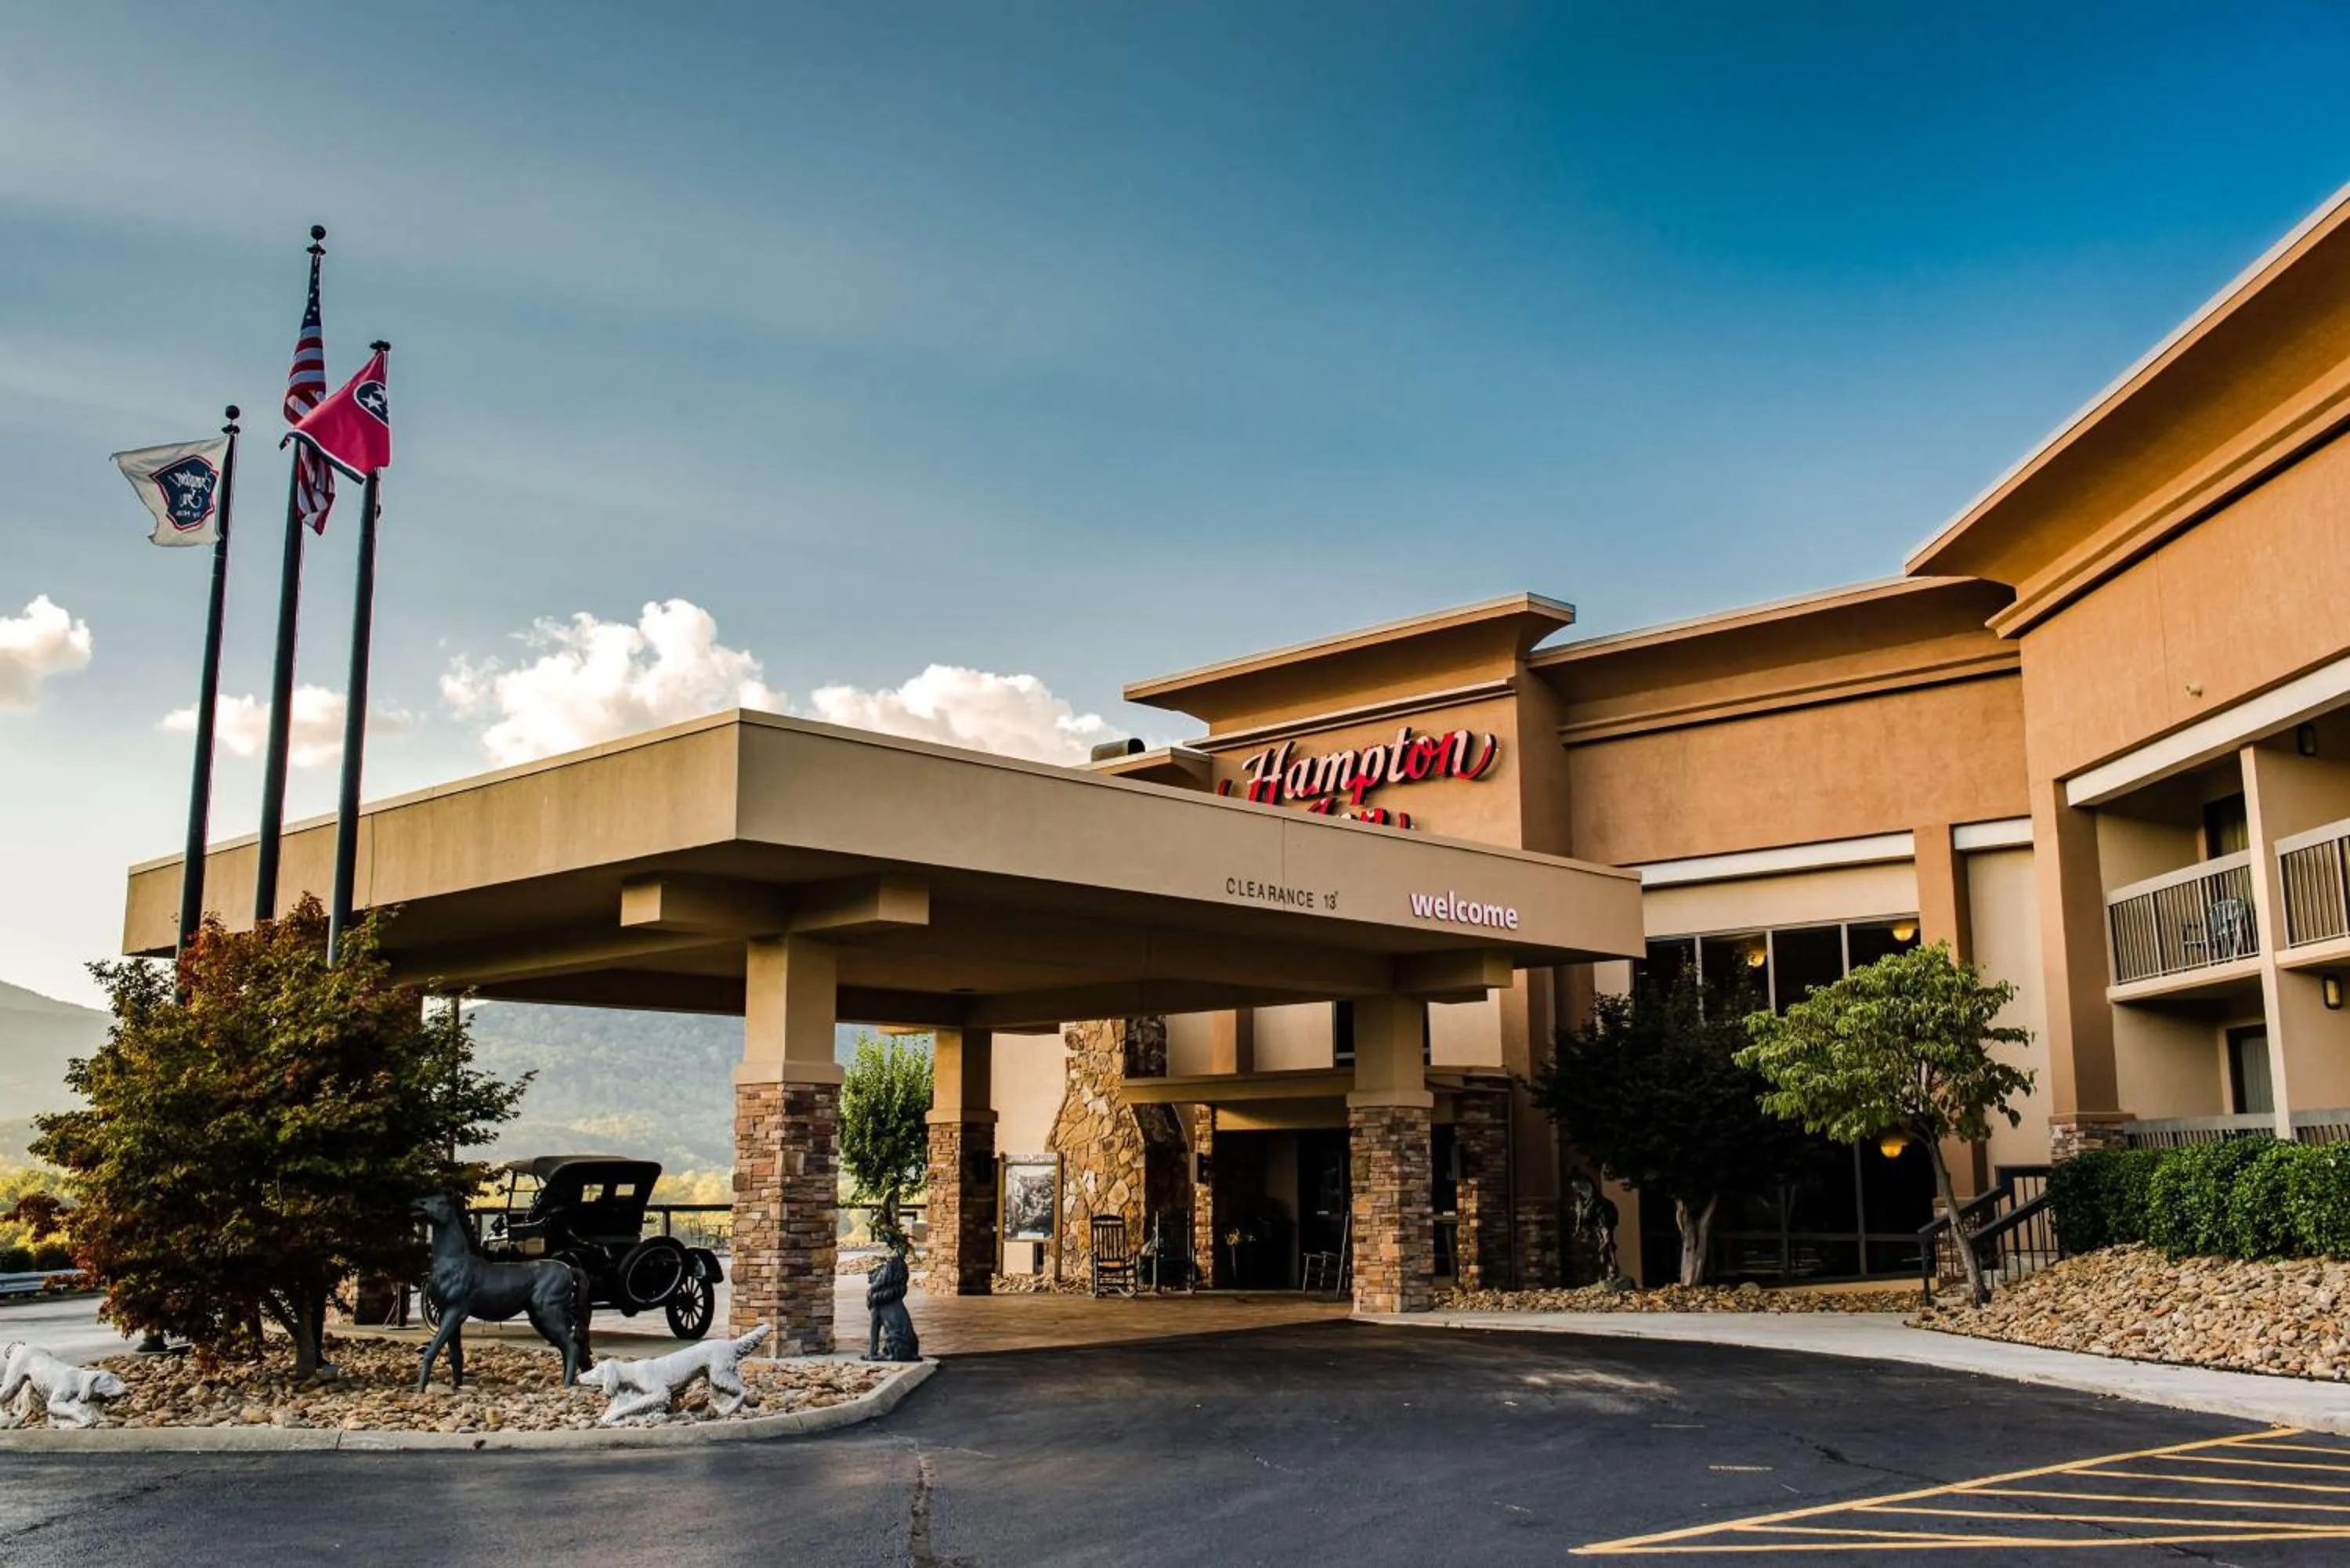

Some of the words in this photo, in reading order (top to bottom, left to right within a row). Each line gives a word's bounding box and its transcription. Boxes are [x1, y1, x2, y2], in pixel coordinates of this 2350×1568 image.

[1222, 726, 1498, 805] Hampton
[1226, 876, 1314, 909] CLEARANCE
[1410, 890, 1518, 930] welcome
